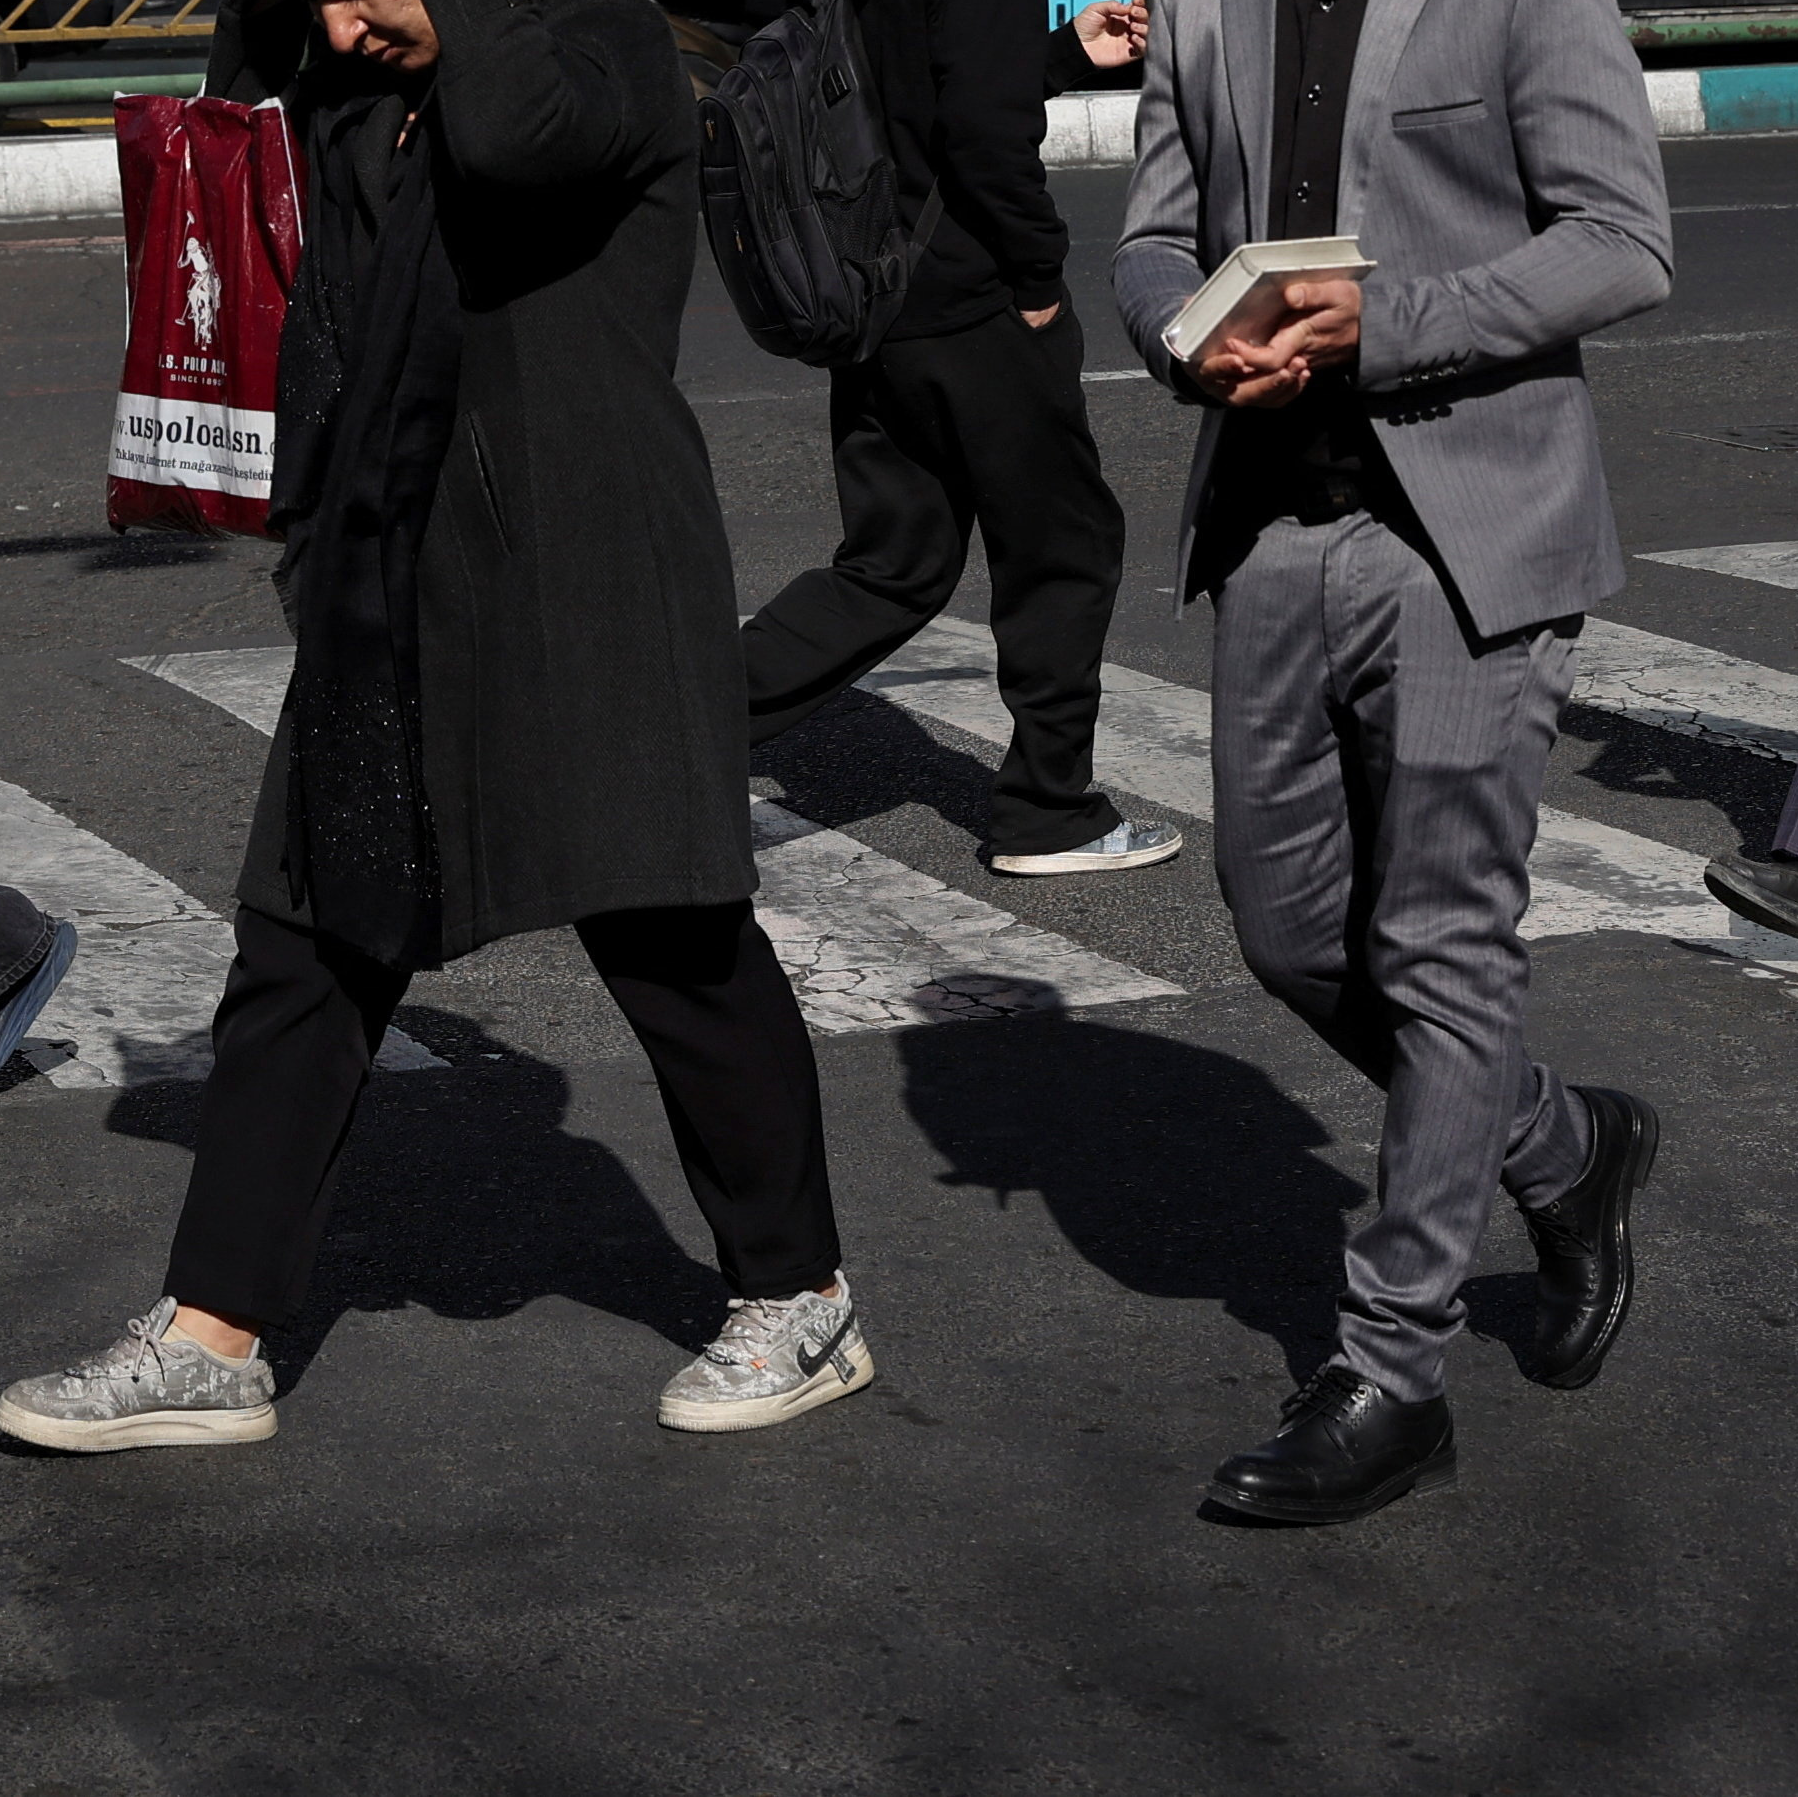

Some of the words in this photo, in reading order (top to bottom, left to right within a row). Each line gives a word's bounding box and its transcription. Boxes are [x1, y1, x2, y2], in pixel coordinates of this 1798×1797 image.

[158, 353, 179, 370] .S.
[183, 355, 207, 373] POLO
[169, 373, 199, 384] SINCE
